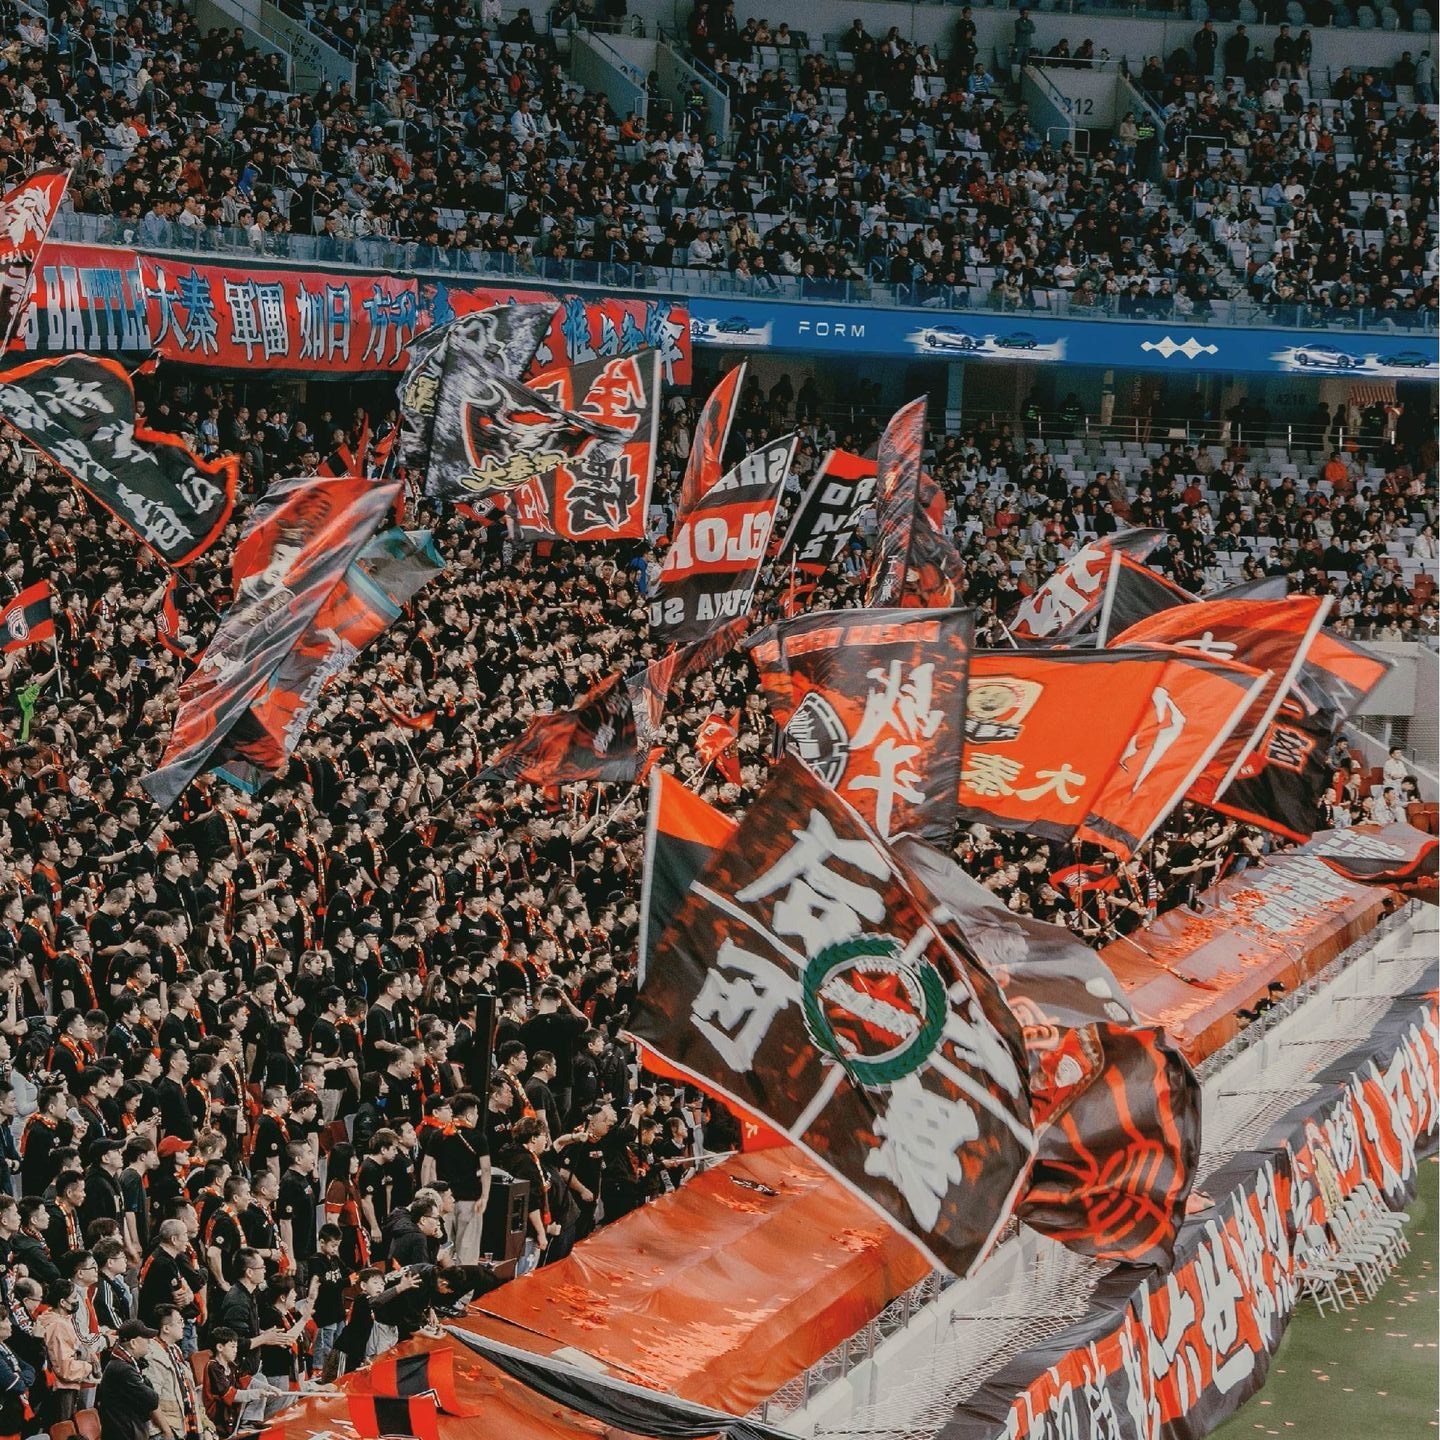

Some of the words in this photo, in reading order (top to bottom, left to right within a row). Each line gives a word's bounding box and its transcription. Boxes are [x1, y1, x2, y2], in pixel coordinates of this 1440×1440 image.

[43, 265, 152, 350] BATTLE
[145, 264, 219, 356] 大秦
[798, 321, 865, 337] FORM
